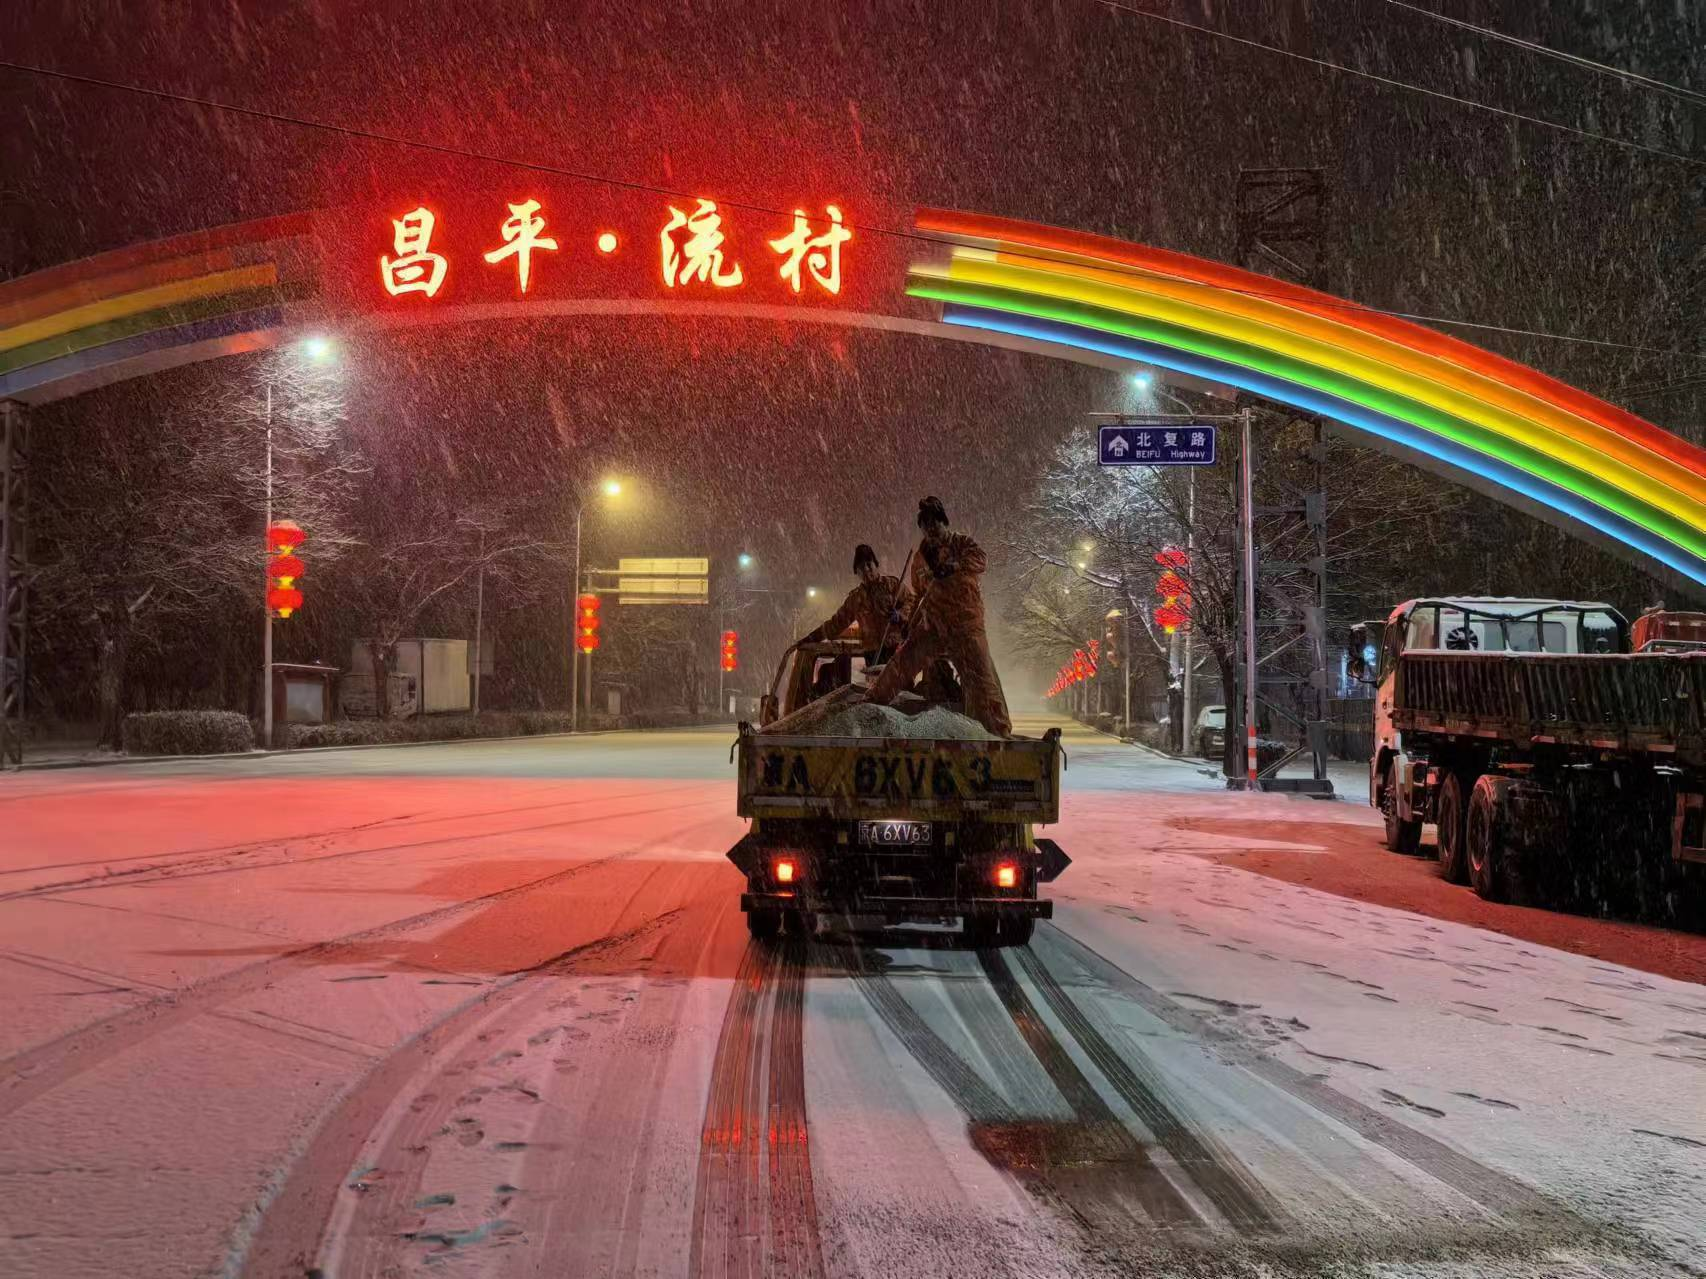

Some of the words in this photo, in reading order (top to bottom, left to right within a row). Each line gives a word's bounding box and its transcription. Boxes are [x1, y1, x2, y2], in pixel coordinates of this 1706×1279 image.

[1136, 432, 1206, 447] 北复路
[1136, 450, 1160, 459] BEIFU
[1170, 450, 1206, 459] Highway
